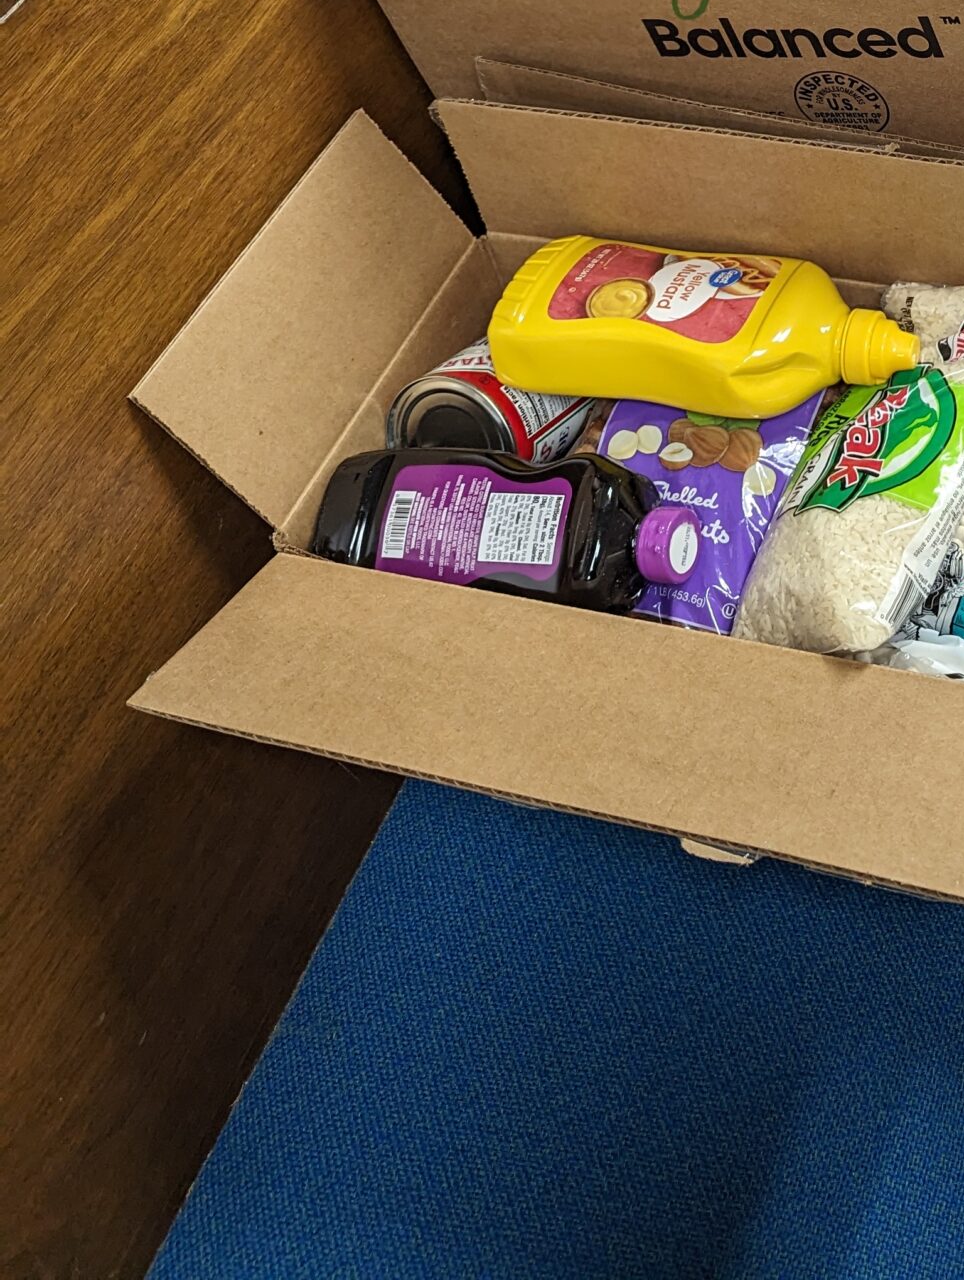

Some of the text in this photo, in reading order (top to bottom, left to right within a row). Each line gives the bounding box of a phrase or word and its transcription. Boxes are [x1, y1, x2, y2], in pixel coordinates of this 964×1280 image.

[641, 15, 944, 59] Balanced
[797, 69, 881, 110] INSPECTED
[825, 95, 859, 113] U.S.
[814, 105, 868, 124] DEPARTMENT
[822, 111, 880, 130] AGRICULTURE
[657, 263, 700, 310] Mustard
[682, 271, 710, 302] Yellow
[502, 385, 540, 436] Nutrition Facts
[809, 413, 848, 448] Rice
[654, 480, 718, 510] Shelled
[785, 454, 824, 508] GRAIN
[551, 496, 562, 521] Nutrition
[548, 524, 556, 539] Facts
[924, 526, 936, 543] arroz
[912, 540, 927, 559] antes
